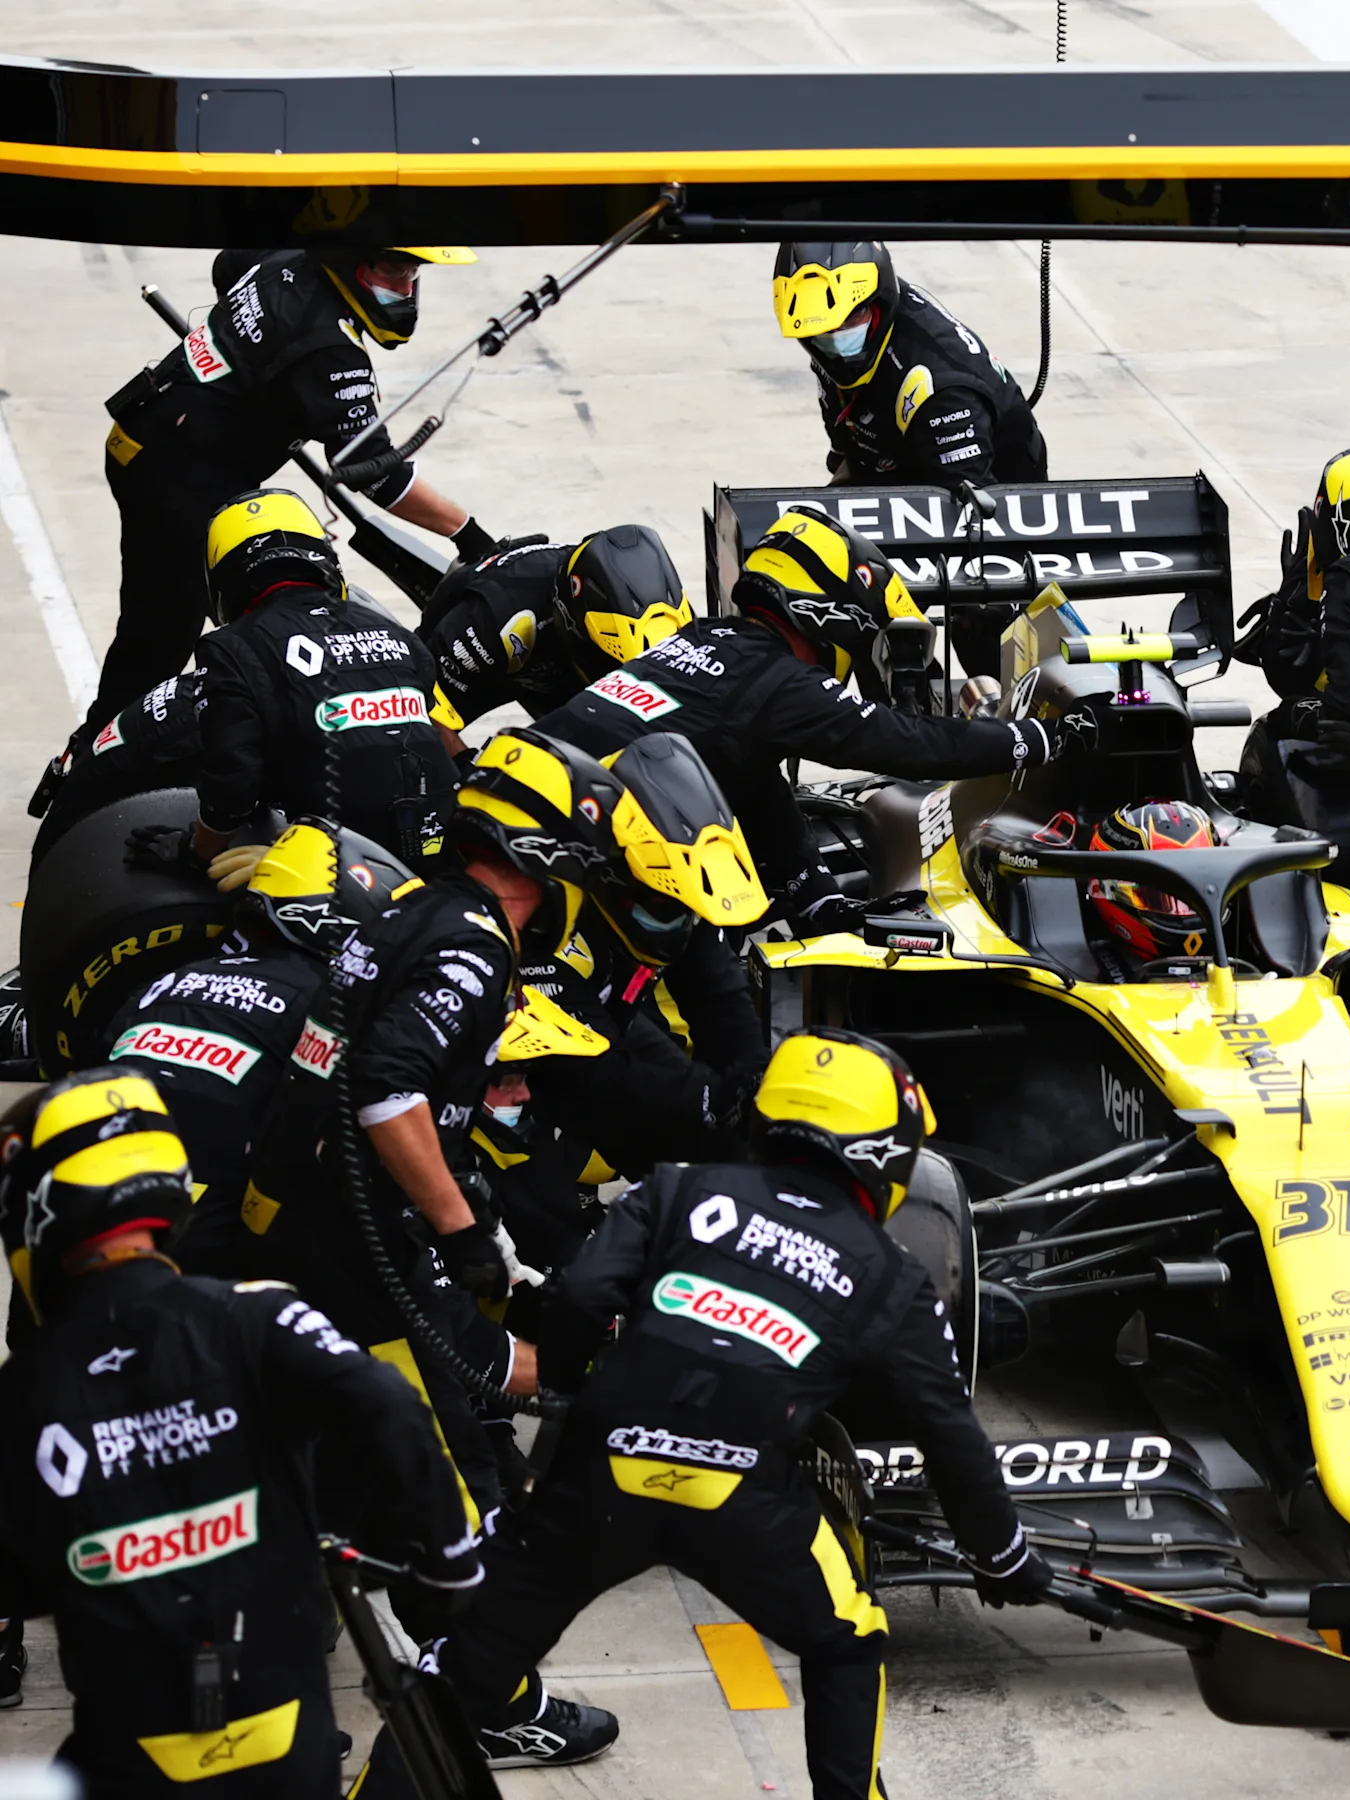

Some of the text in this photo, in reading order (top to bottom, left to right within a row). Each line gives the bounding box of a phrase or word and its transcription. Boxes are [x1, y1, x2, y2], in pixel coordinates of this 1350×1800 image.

[330, 369, 370, 382] DP WORLD
[929, 409, 971, 427] DP WORLD
[939, 444, 982, 464] PIRELLI
[887, 550, 1175, 584] WORLD
[330, 639, 410, 656] DP WORLD
[360, 652, 403, 664] TEAM
[471, 637, 495, 665] WORLD
[351, 694, 428, 721] Castrol
[594, 674, 667, 714] Castrol
[1008, 723, 1024, 742] Ross
[898, 937, 933, 950] Castrol
[63, 924, 184, 1018] ZERO
[185, 972, 268, 990] RENAULT
[518, 965, 556, 976] WORLD
[176, 979, 286, 1014] DP WORLD
[202, 992, 254, 1013] TEAM
[134, 1028, 247, 1075] Castrol
[1211, 1013, 1313, 1125] RENAULT
[1101, 1064, 1144, 1140] verti
[750, 1213, 840, 1263] RENAULT
[742, 1224, 854, 1298] DP WORLD
[772, 1253, 826, 1293] TEAM
[692, 1290, 807, 1359] Castrol
[1297, 1311, 1322, 1326] DP
[92, 1399, 195, 1440] RENAULT
[96, 1407, 238, 1464] DP WORLD
[144, 1439, 211, 1469] TEAM
[994, 1436, 1173, 1486] ORLD
[116, 1502, 248, 1573] Castrol
